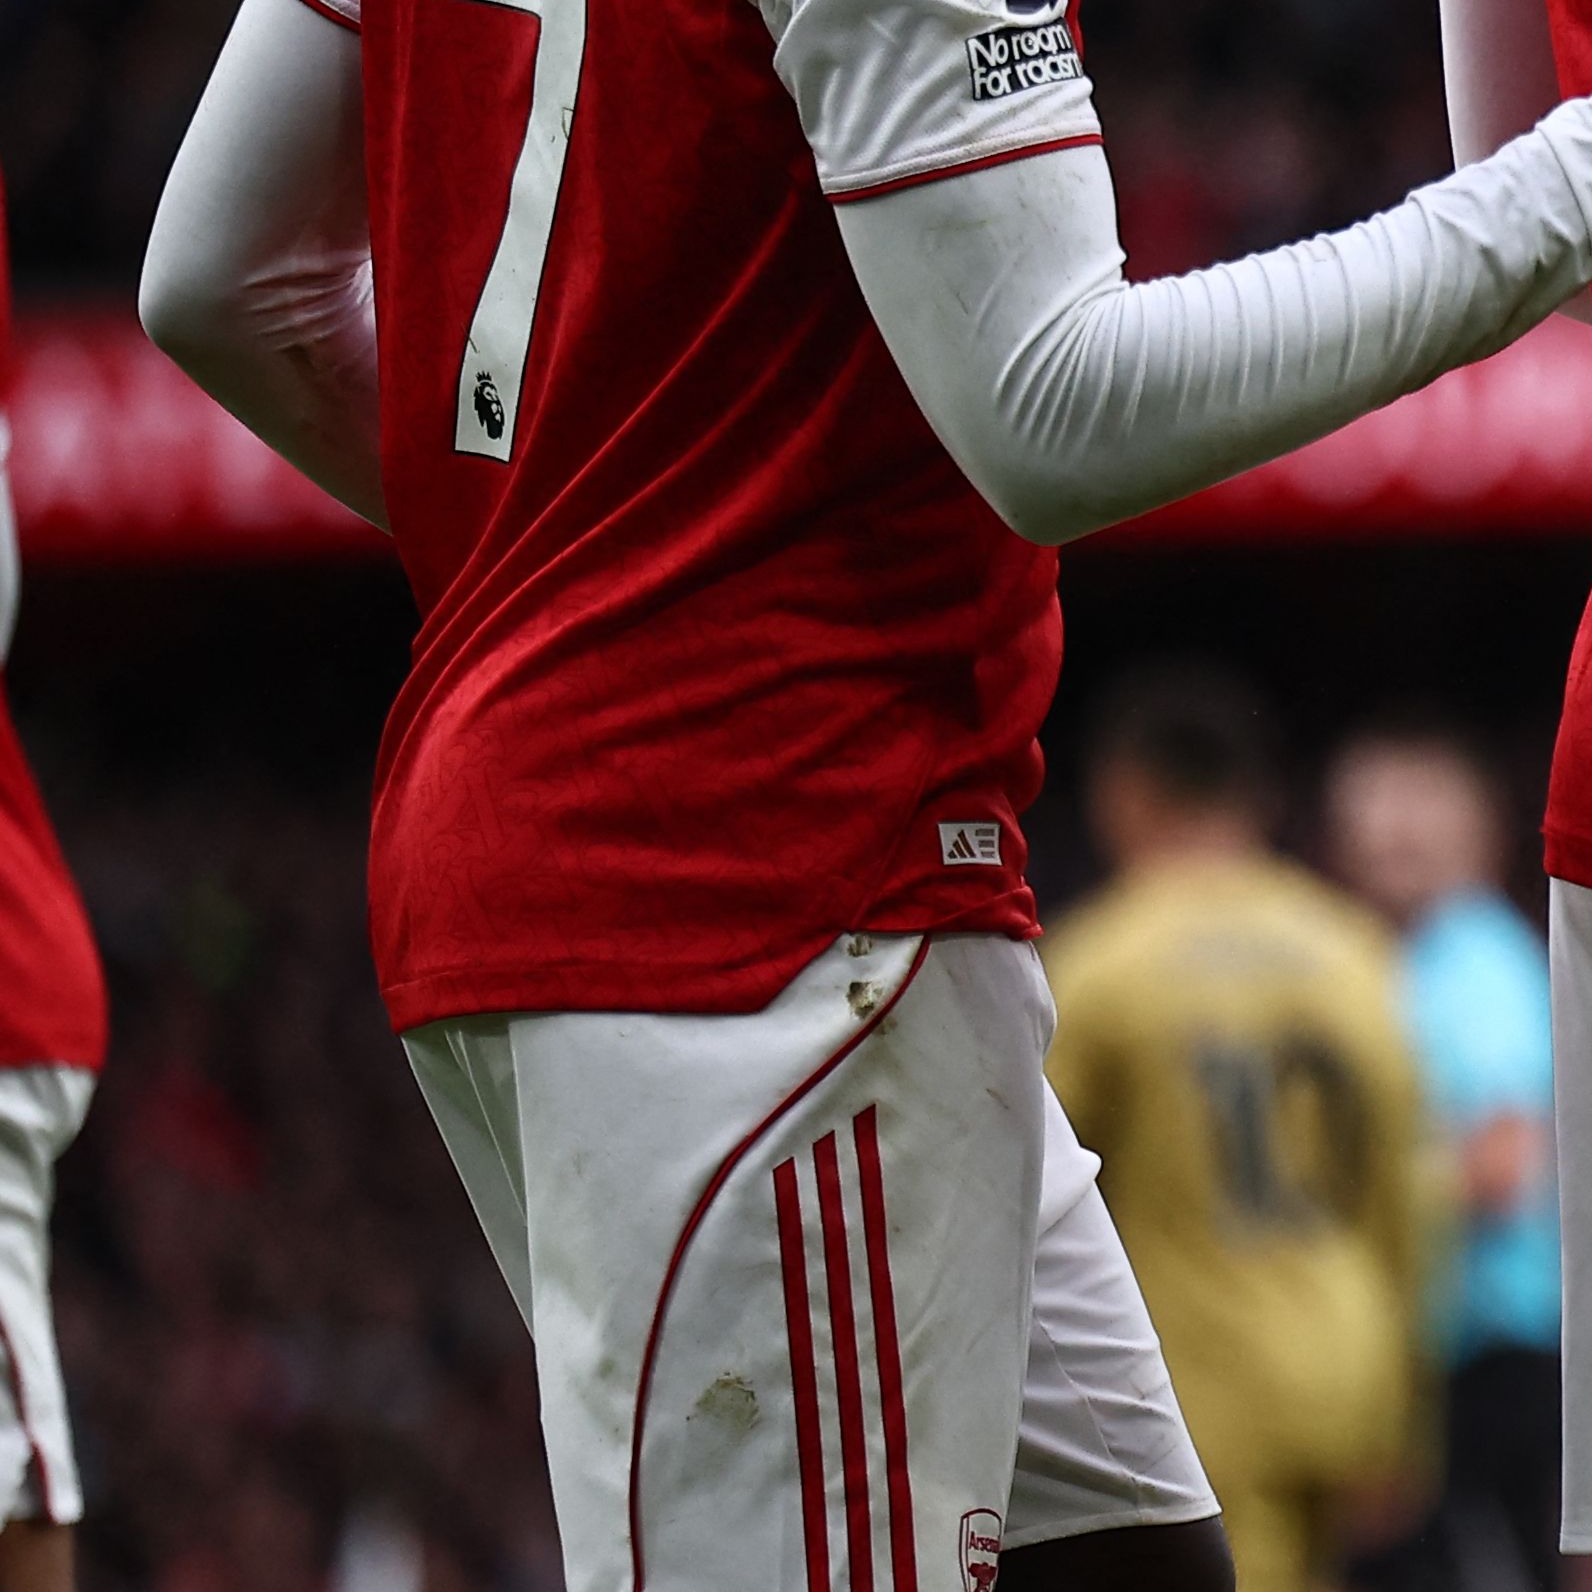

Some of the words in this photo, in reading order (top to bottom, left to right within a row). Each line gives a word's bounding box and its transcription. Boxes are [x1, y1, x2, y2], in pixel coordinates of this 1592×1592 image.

[967, 33, 1009, 69] No
[1011, 24, 1072, 60] room
[973, 66, 1012, 101] For
